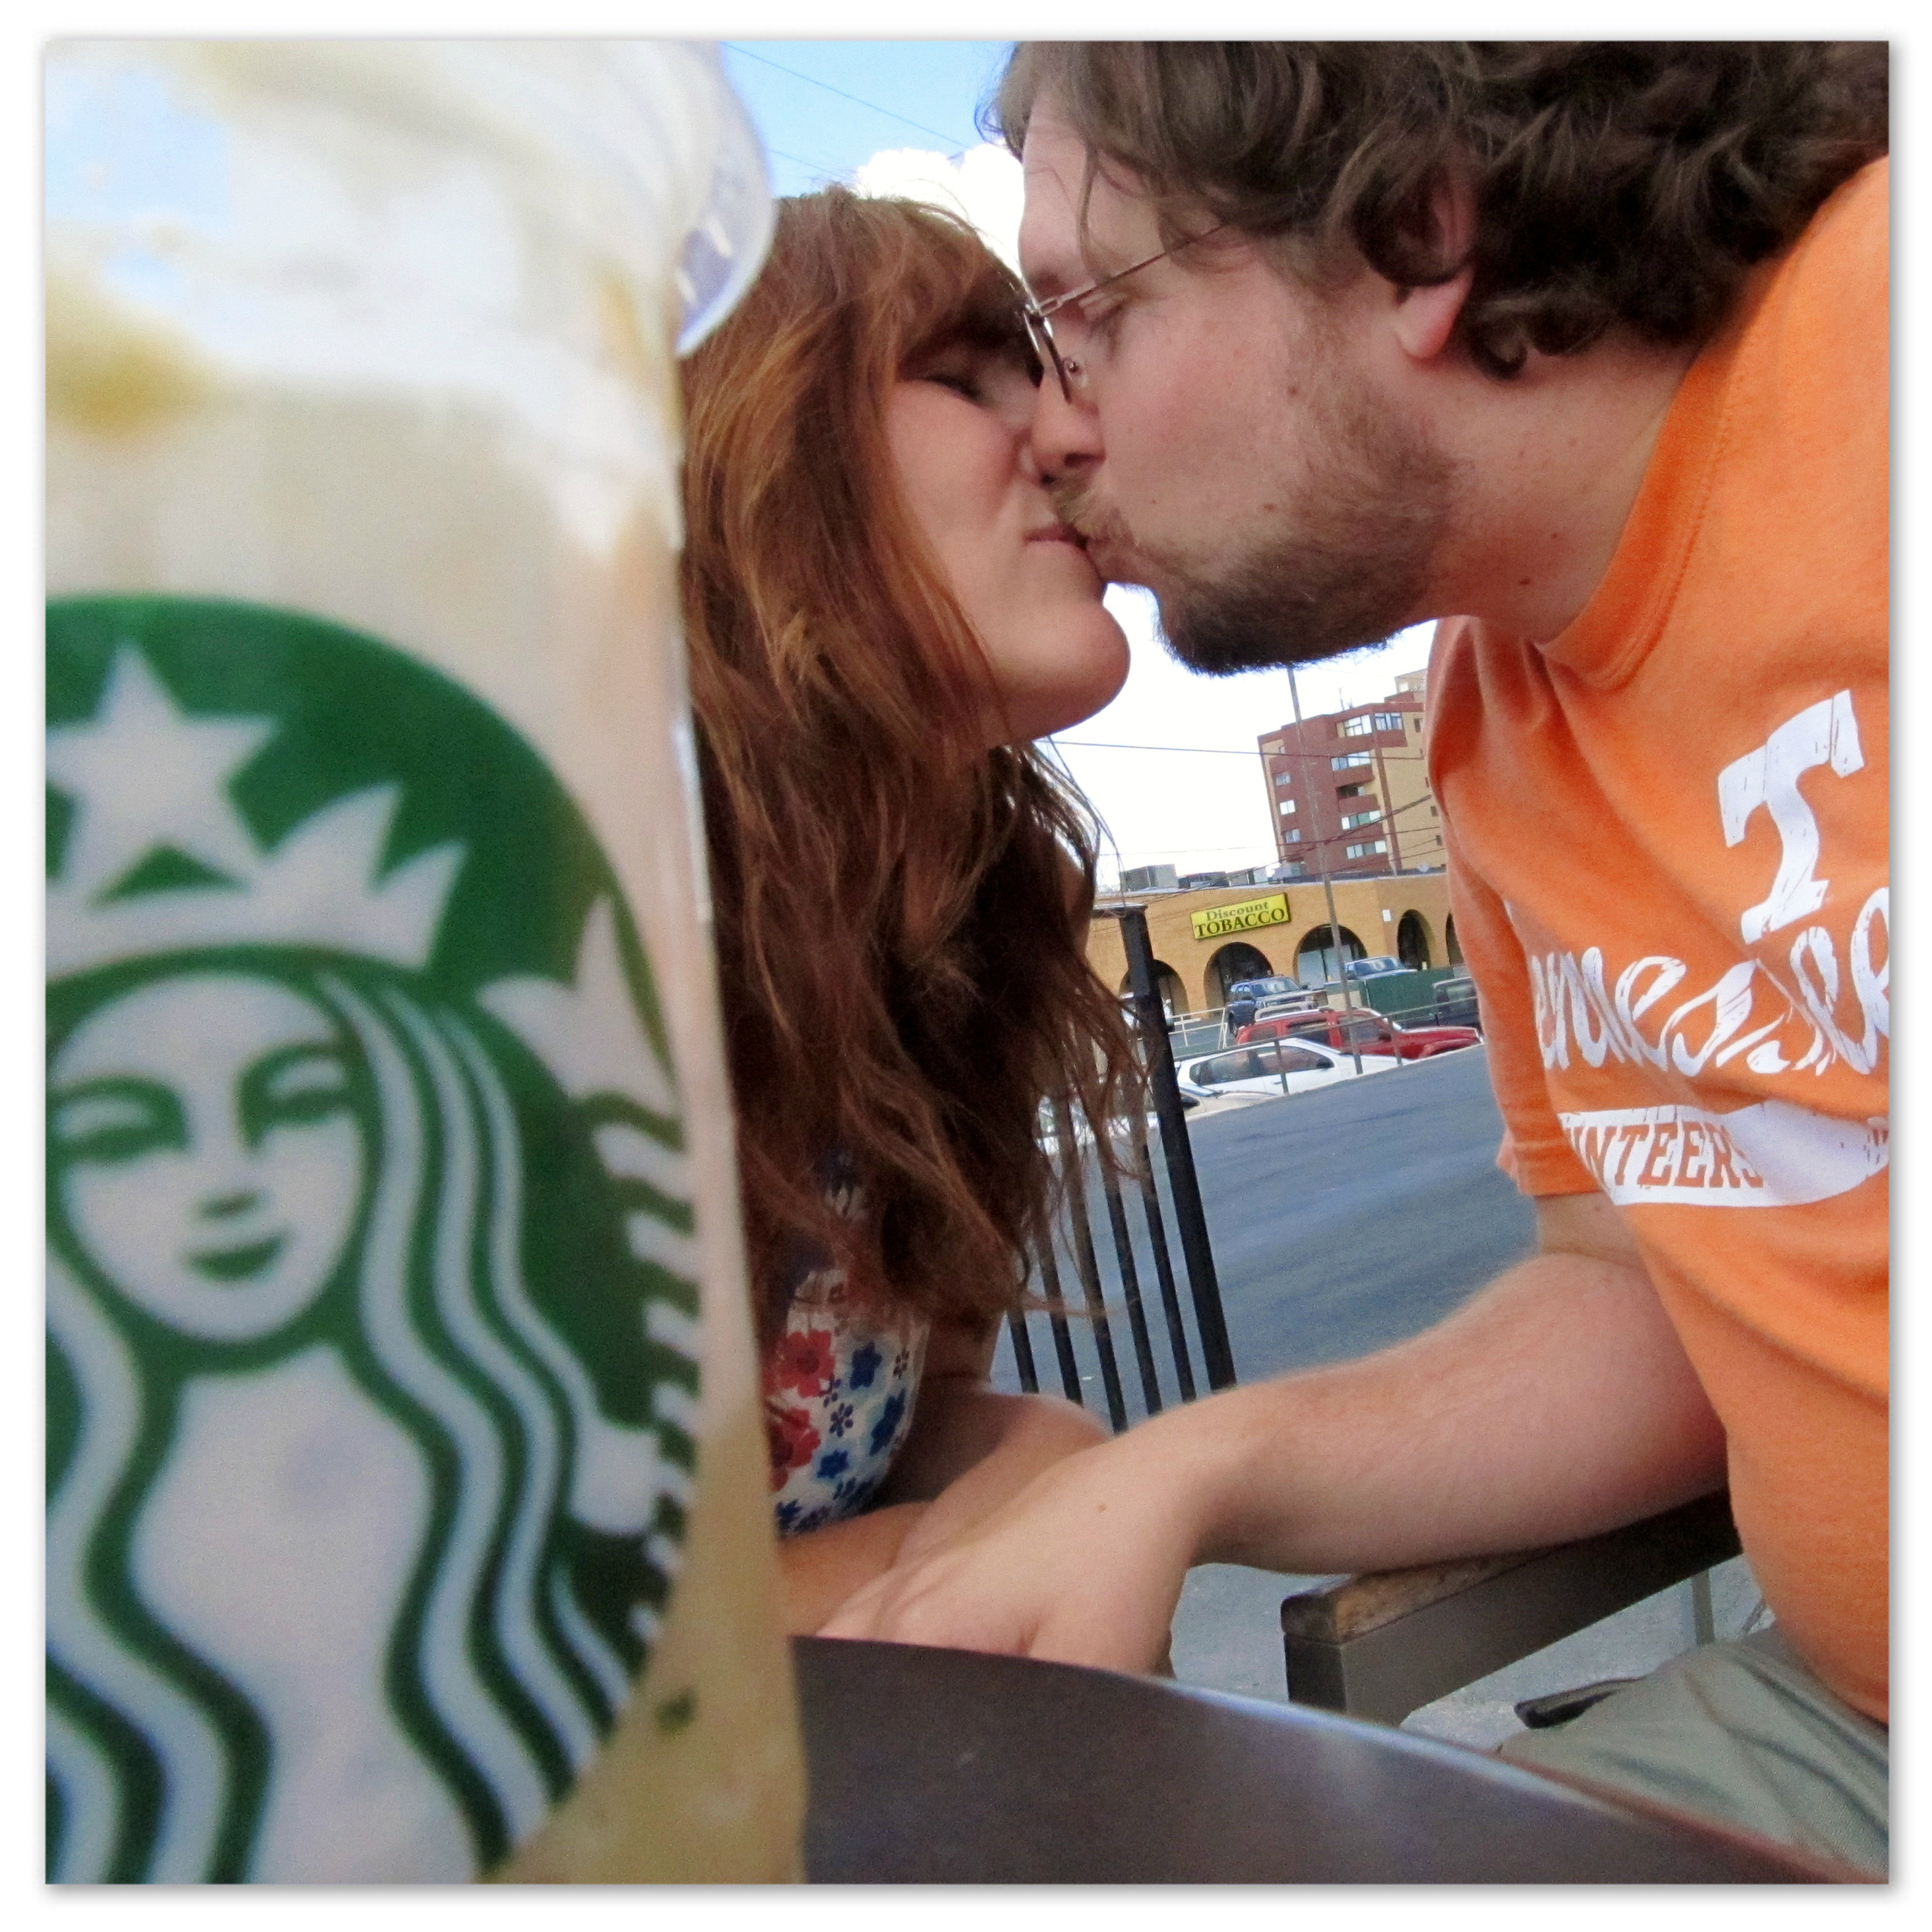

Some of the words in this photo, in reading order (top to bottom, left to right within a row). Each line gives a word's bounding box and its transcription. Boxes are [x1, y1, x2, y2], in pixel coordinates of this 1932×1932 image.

[1718, 689, 1864, 945] T
[1195, 907, 1285, 937] TOBACCO
[1206, 901, 1269, 921] Discount
